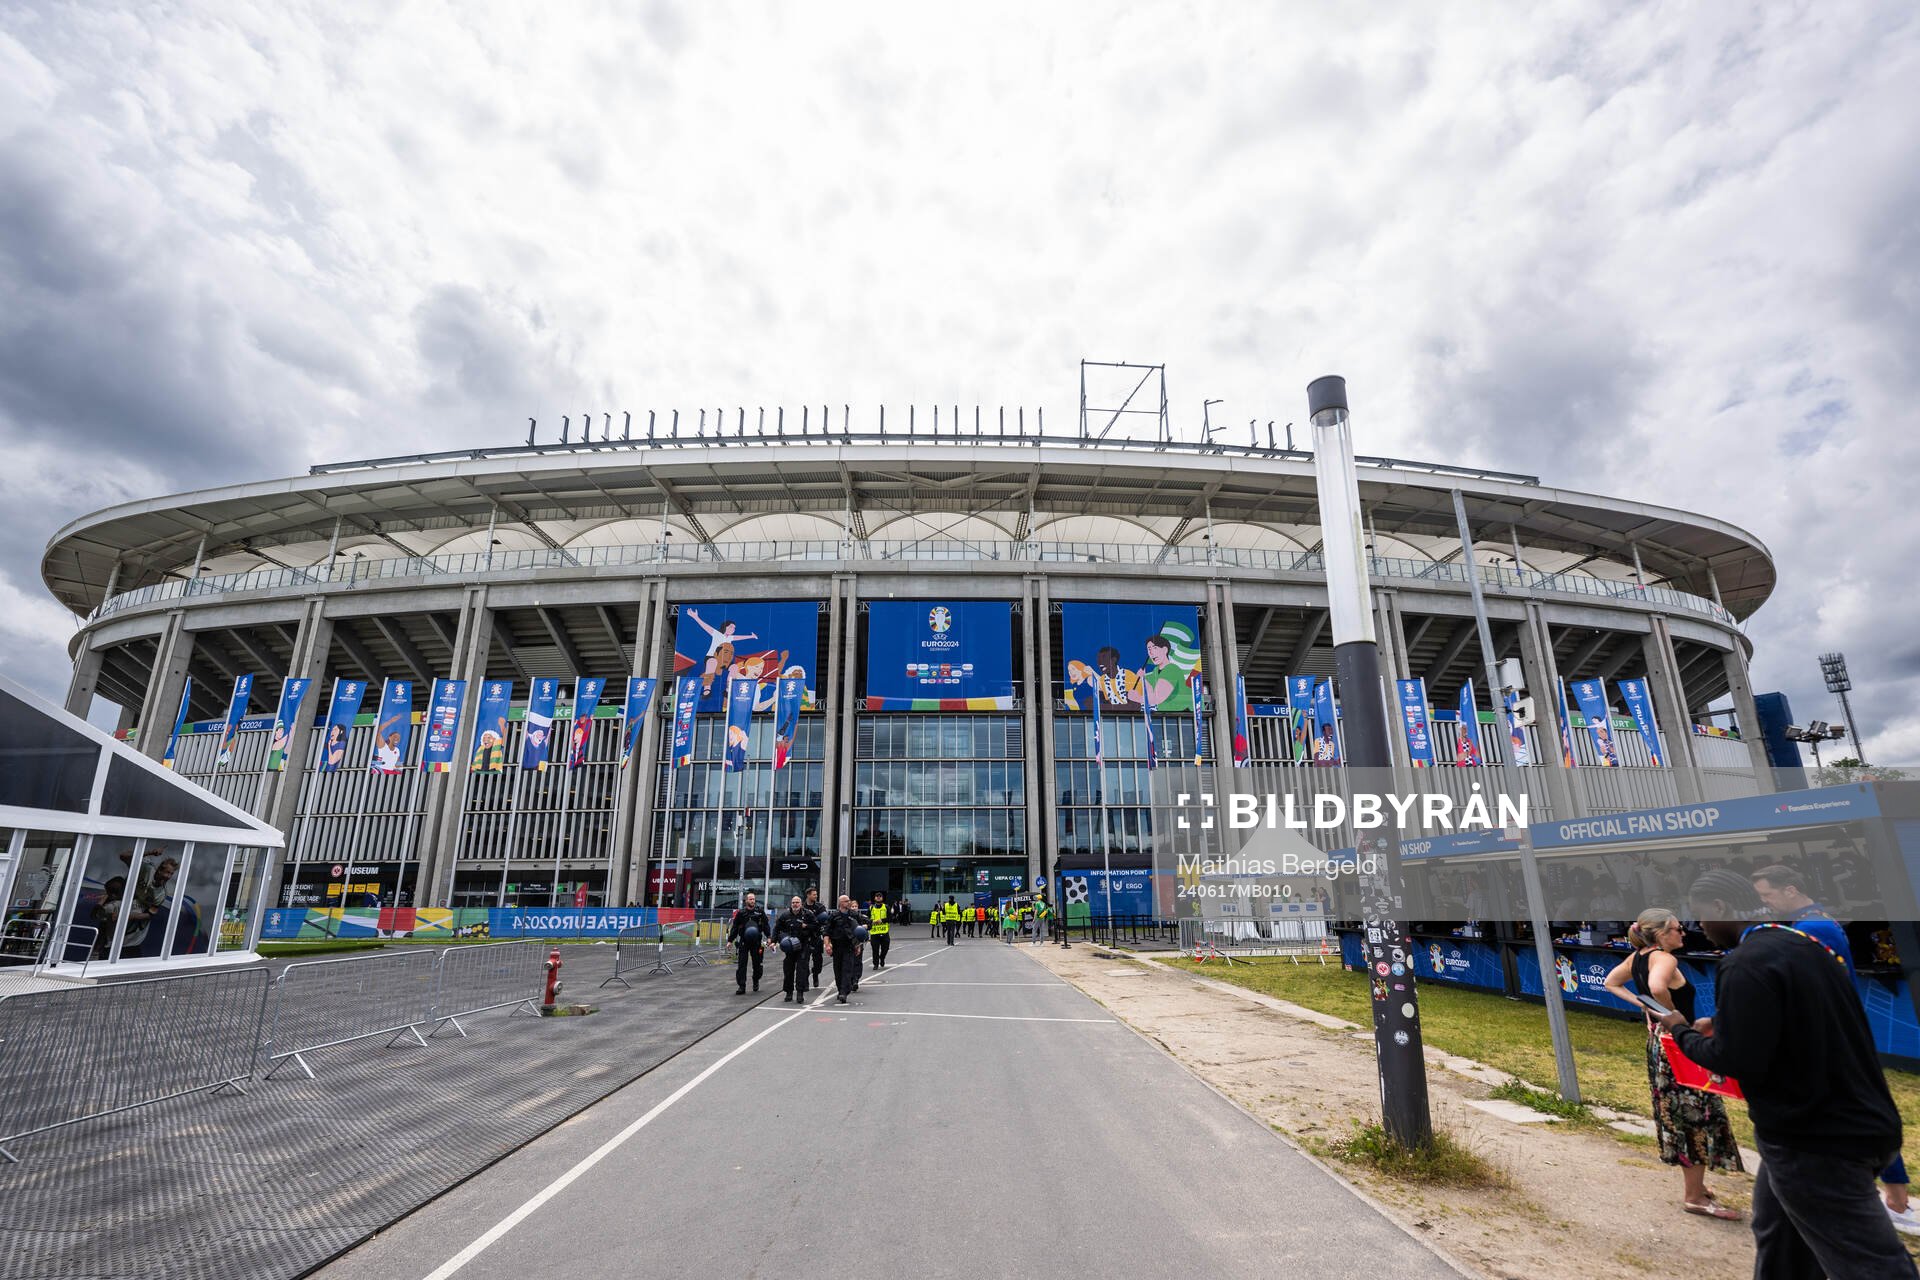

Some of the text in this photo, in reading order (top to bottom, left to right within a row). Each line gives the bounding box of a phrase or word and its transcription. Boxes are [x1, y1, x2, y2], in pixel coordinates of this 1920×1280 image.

[921, 640, 960, 648] EURO2024
[1560, 807, 1720, 840] OFFICIAL FAN SHOP
[1408, 841, 1431, 854] SHOP
[1580, 974, 1606, 986] EURO2
